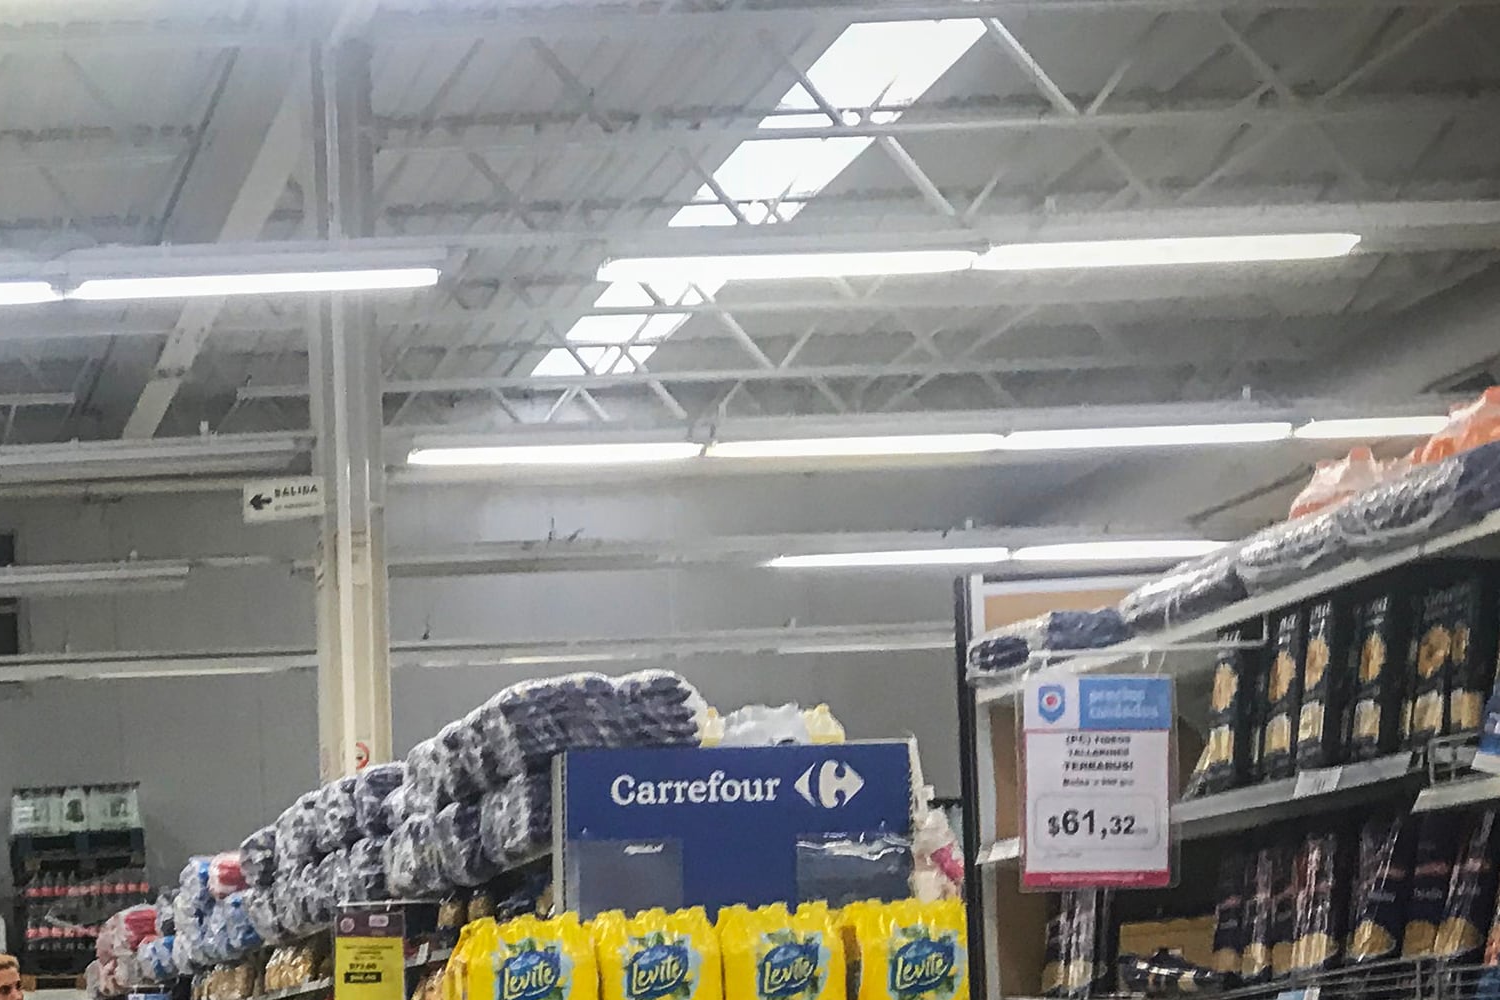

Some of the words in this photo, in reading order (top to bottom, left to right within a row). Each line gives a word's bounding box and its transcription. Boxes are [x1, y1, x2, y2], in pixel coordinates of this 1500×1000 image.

[610, 769, 781, 807] Carrefour
[1047, 809, 1136, 841] $61,32
[503, 959, 556, 1000] Levite
[631, 954, 684, 996] Levite
[764, 955, 814, 994] Levite
[895, 951, 949, 989] Levite
